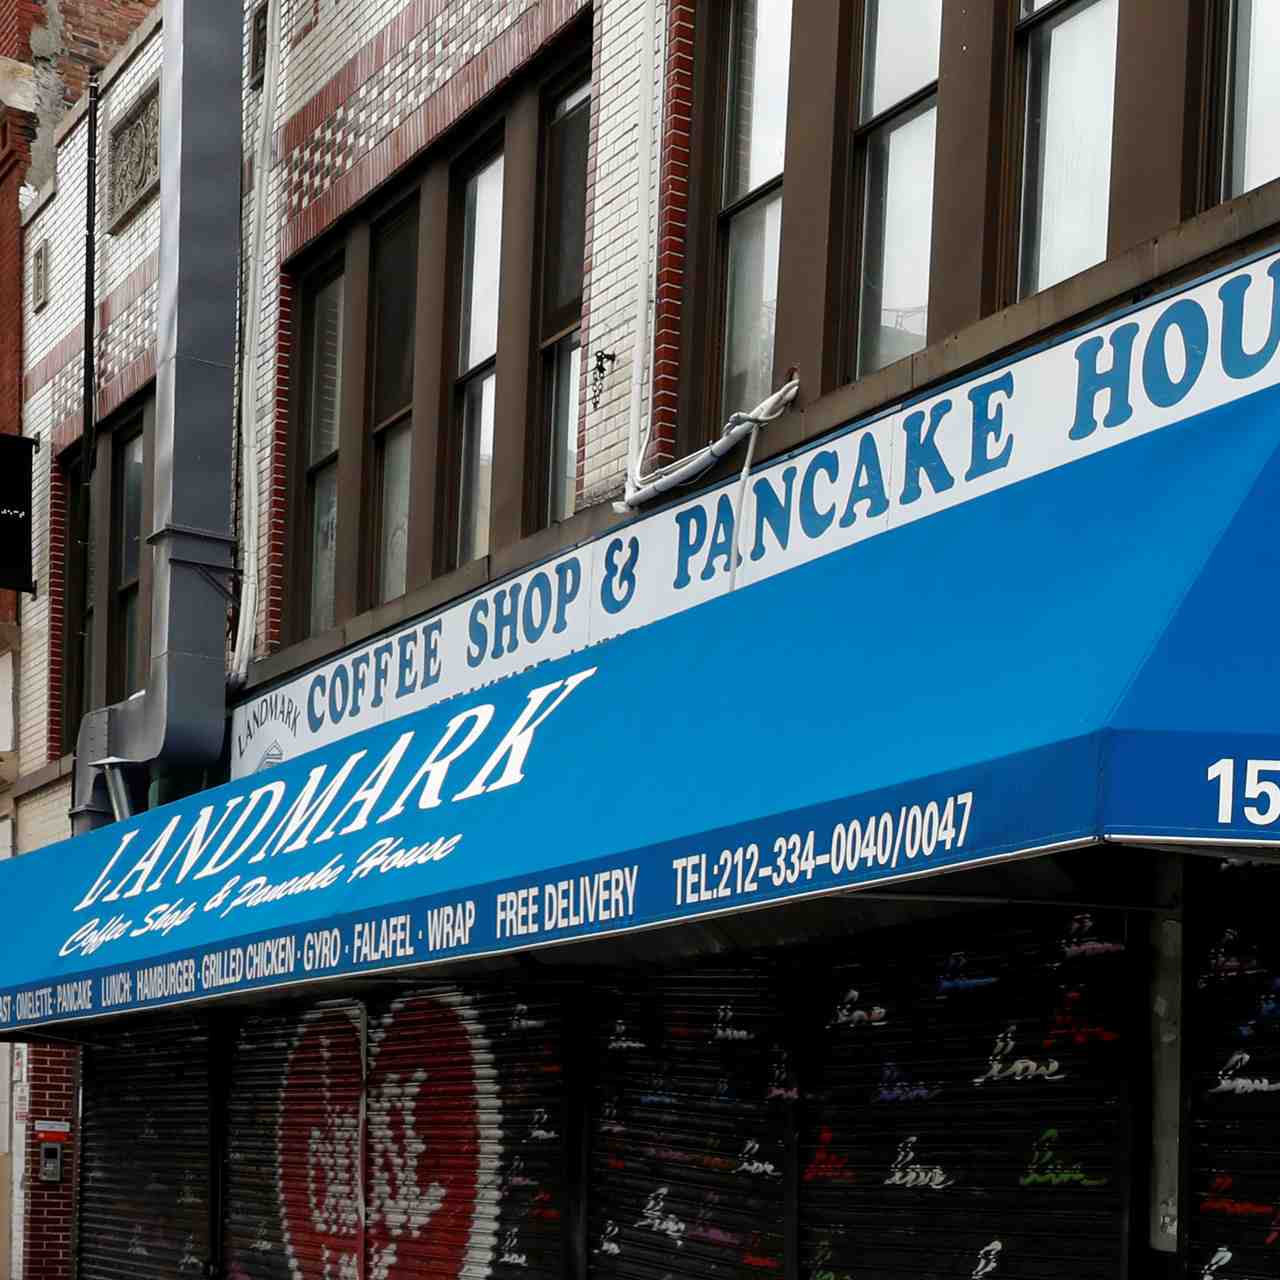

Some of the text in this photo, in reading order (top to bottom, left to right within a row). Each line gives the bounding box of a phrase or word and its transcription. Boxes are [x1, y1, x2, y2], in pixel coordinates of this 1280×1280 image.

[307, 619, 442, 733] COFFEE
[467, 558, 581, 667] SHOP
[601, 537, 639, 614] &
[673, 373, 1014, 591] PANCAKE
[73, 666, 597, 911] LANDMARK
[237, 693, 301, 757] LANDMARK
[58, 832, 463, 957] Coffee Shop & Pancake House
[136, 958, 195, 1002] HAMBURGER
[202, 946, 243, 990] GRILLED
[246, 936, 296, 979] CHICKEN
[304, 927, 341, 970] GYRO
[353, 913, 415, 964] FALAFEL
[427, 900, 476, 950] WRAP
[496, 887, 539, 939] FREE
[544, 865, 639, 928] DELIVERY
[672, 791, 973, 906] TEL:212-334-0040/0047
